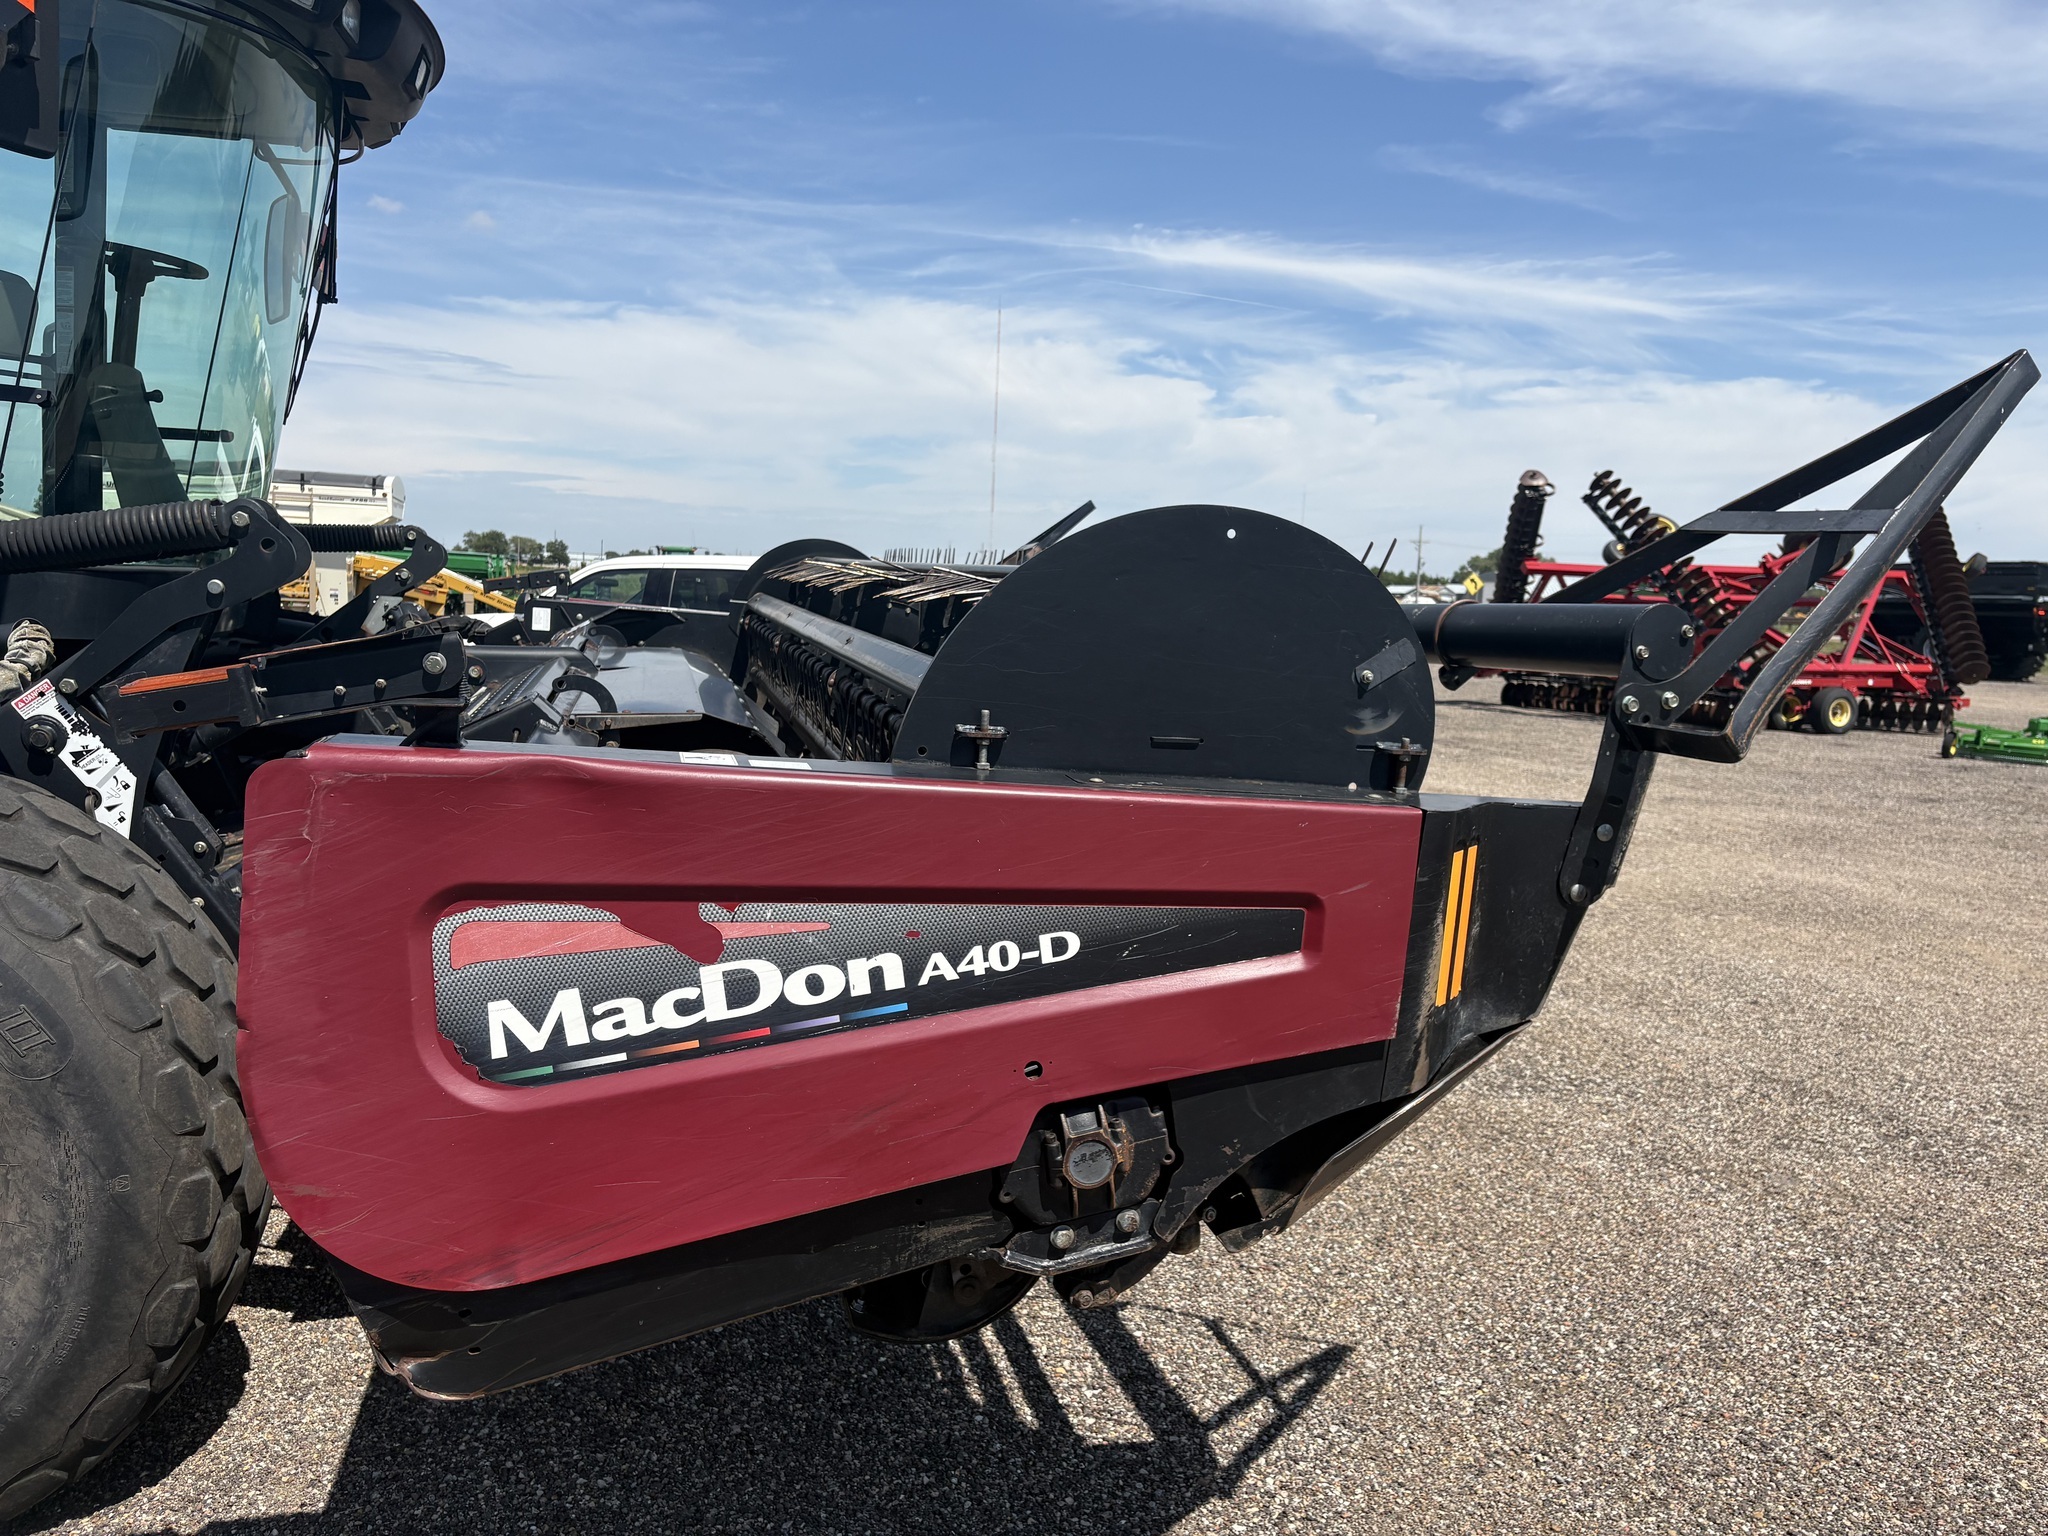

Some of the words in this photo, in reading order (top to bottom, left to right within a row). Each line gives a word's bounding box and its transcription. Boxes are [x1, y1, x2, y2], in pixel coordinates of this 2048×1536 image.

[24, 683, 50, 703] DANGER
[487, 952, 906, 1060] MacDon
[917, 931, 1081, 986] A40-D
